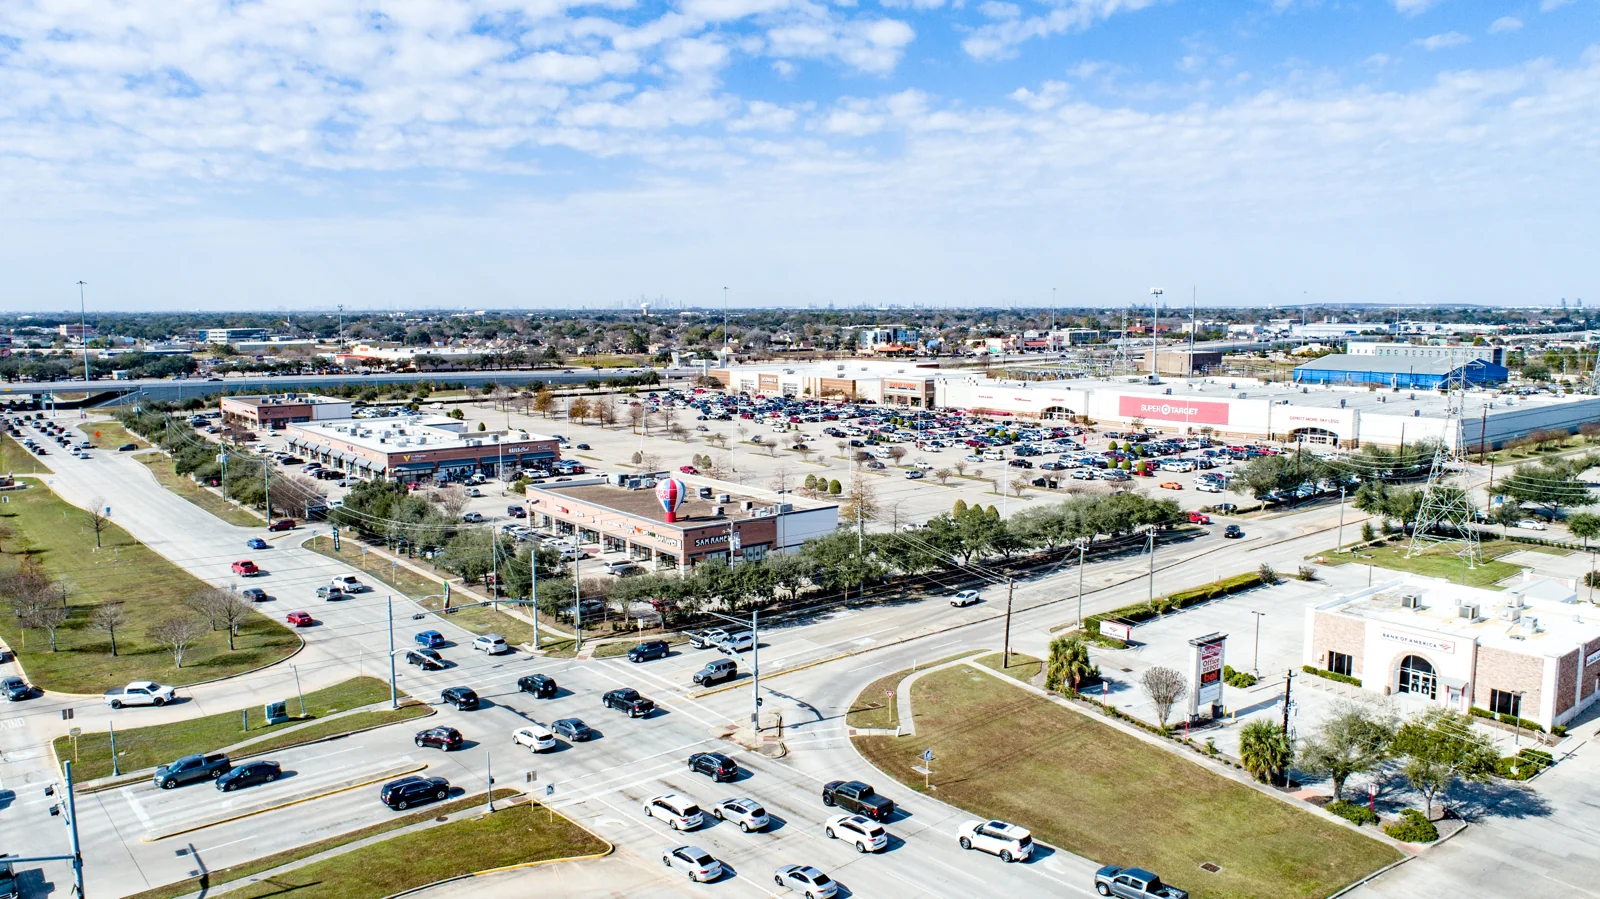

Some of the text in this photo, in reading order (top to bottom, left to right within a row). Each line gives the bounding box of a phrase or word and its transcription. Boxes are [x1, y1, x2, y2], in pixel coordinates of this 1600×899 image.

[1140, 404, 1198, 416] SUPER TARGET
[1409, 638, 1437, 648] AMERICA
[1202, 658, 1220, 667] Office
[1202, 664, 1219, 672] DEPOT
[1204, 670, 1218, 682] bel
